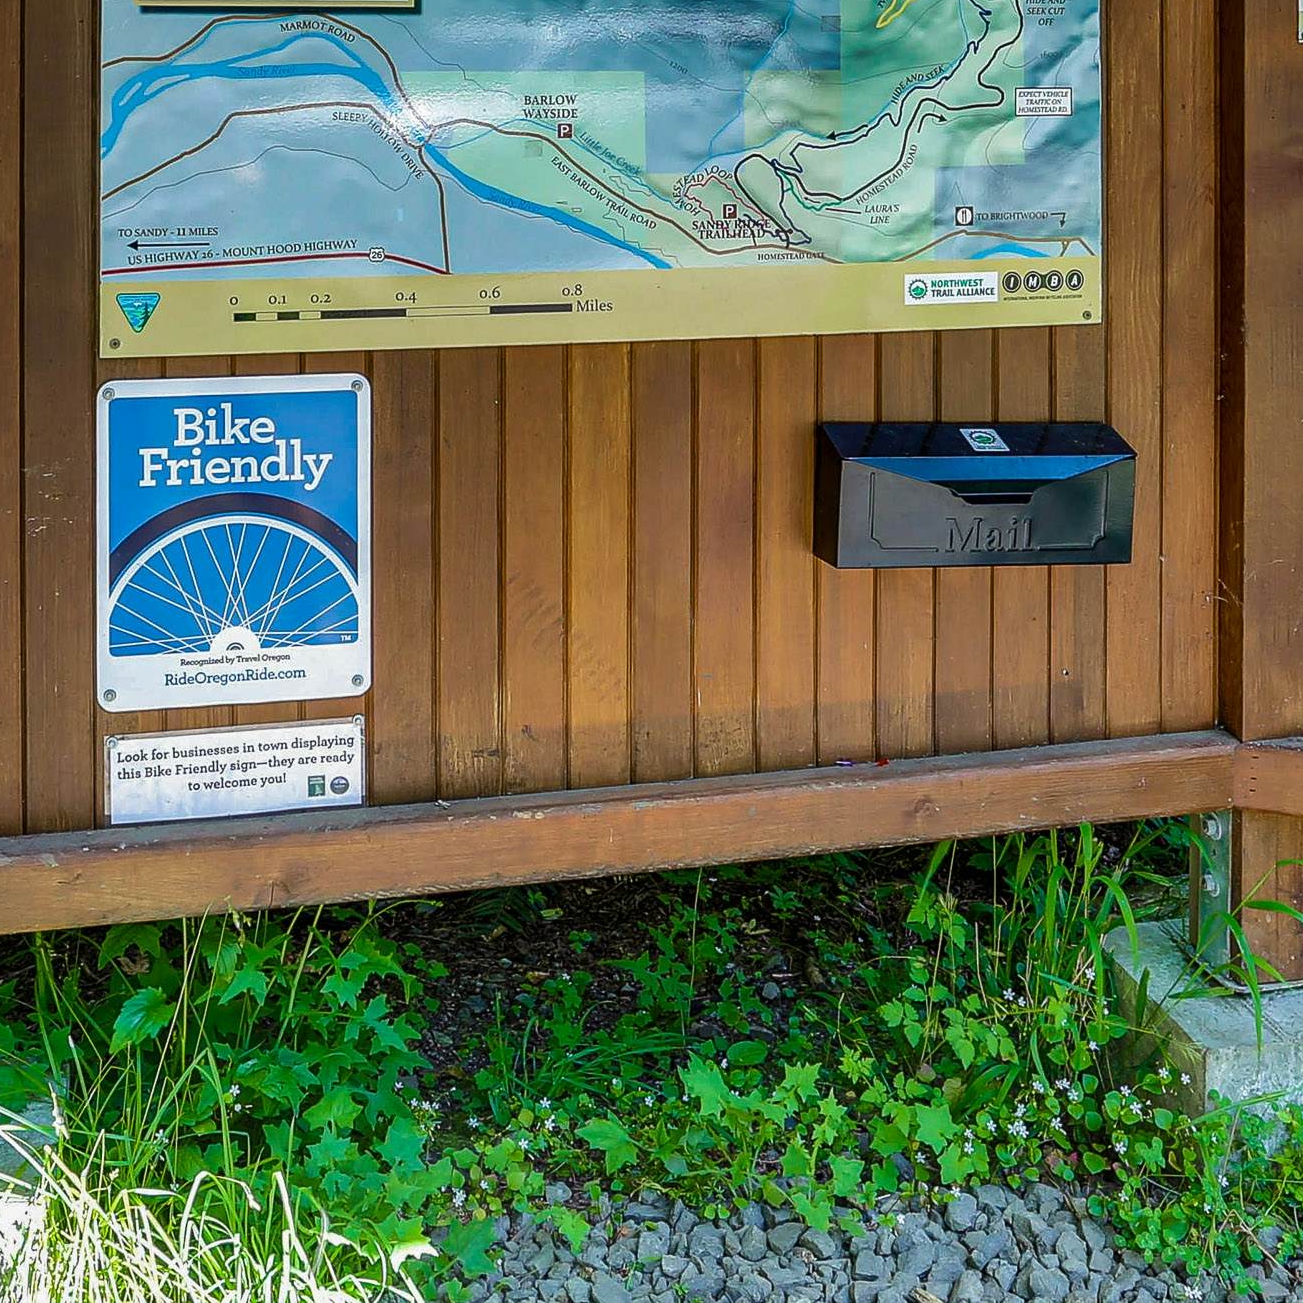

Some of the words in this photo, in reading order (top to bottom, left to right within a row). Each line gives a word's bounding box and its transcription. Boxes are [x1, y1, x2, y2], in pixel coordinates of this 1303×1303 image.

[523, 93, 578, 109] BARLOW
[521, 107, 578, 122] WAYSIDE
[977, 212, 990, 223] TO
[990, 211, 1050, 223] BRIGHTWOOD
[930, 278, 985, 290] NORTHWEST
[930, 288, 955, 297] TRAIL
[956, 287, 995, 297] ALLIANCE
[265, 291, 287, 306] 0.1
[308, 291, 333, 307] 0.2
[391, 288, 417, 306] 0.4
[476, 284, 504, 302] 0.6
[561, 281, 584, 300] 0.8
[574, 297, 613, 313] Miles
[173, 403, 277, 450] Bike
[138, 438, 333, 491] Friendly
[945, 516, 1033, 553] Mail
[164, 667, 306, 686] RideOregonRide.com
[116, 749, 148, 763] Look
[151, 748, 169, 760] for
[171, 745, 240, 763] businesses
[242, 742, 255, 753] in
[257, 741, 288, 759] town
[290, 734, 355, 753] displaying
[187, 781, 200, 791] to
[202, 776, 257, 790] welcome
[259, 772, 286, 788] you!
